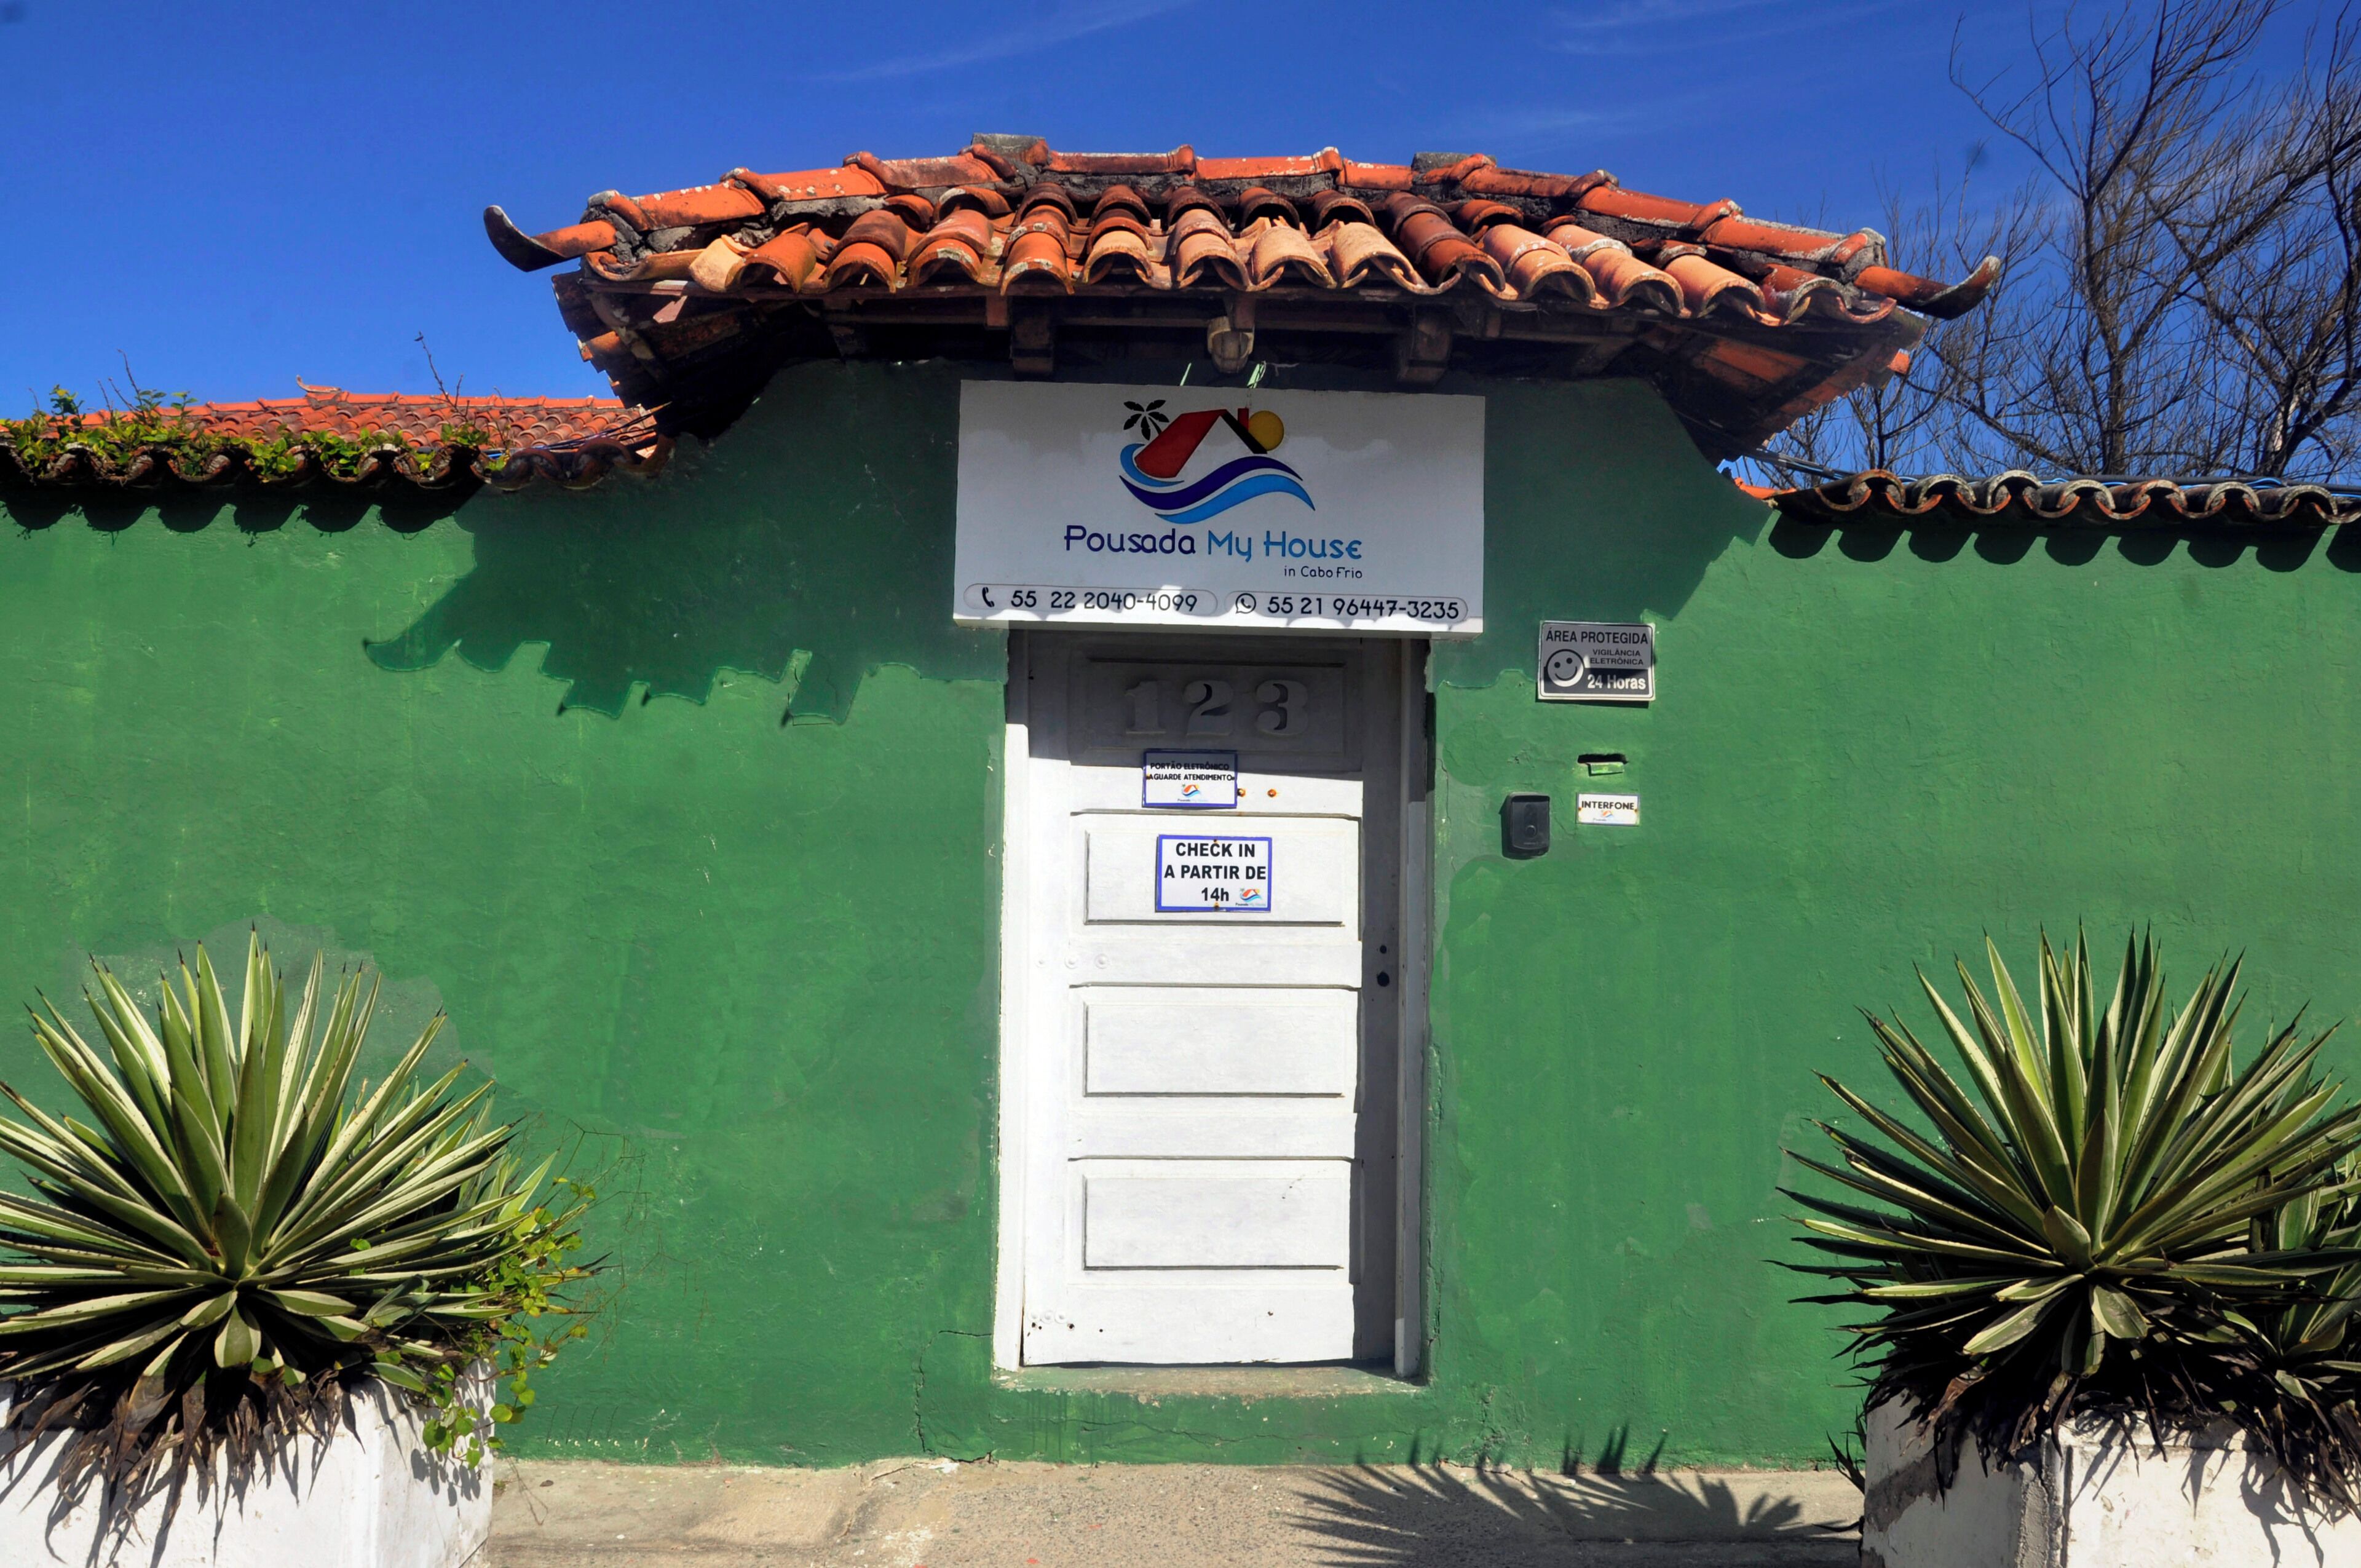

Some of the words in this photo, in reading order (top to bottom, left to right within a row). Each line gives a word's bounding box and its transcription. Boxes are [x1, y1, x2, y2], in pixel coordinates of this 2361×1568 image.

[1064, 525, 1196, 554] Pousada
[1208, 530, 1252, 563] My
[1264, 530, 1362, 560] House
[1284, 565, 1295, 577] in
[1300, 566, 1334, 578] Cabo
[1336, 566, 1363, 579] Frio
[1011, 590, 1037, 608] 55
[1051, 591, 1075, 609] 22
[1083, 592, 1198, 612] 2040-4099
[1267, 596, 1294, 614] 55
[1300, 597, 1323, 615] 21
[1333, 598, 1460, 619] 96447-3235
[1546, 627, 1577, 643] ÁREA
[1581, 631, 1648, 644] PROTEGIDA
[1592, 648, 1641, 657] VIGILÂNCIA
[1589, 657, 1643, 665] ELETRÔNICA
[1587, 674, 1604, 689] 24
[1607, 674, 1647, 690] Horas
[1125, 679, 1309, 736] 123
[1150, 761, 1182, 770] PORTÃO
[1184, 761, 1230, 770] ELETRÔNICO
[1581, 801, 1635, 810] INTERFONE
[1176, 842, 1233, 857] CHECK
[1239, 844, 1256, 857] IN
[1164, 865, 1175, 879] A
[1180, 865, 1240, 879] PARTIR
[1245, 866, 1267, 880] DE
[1201, 887, 1229, 901] 14h
